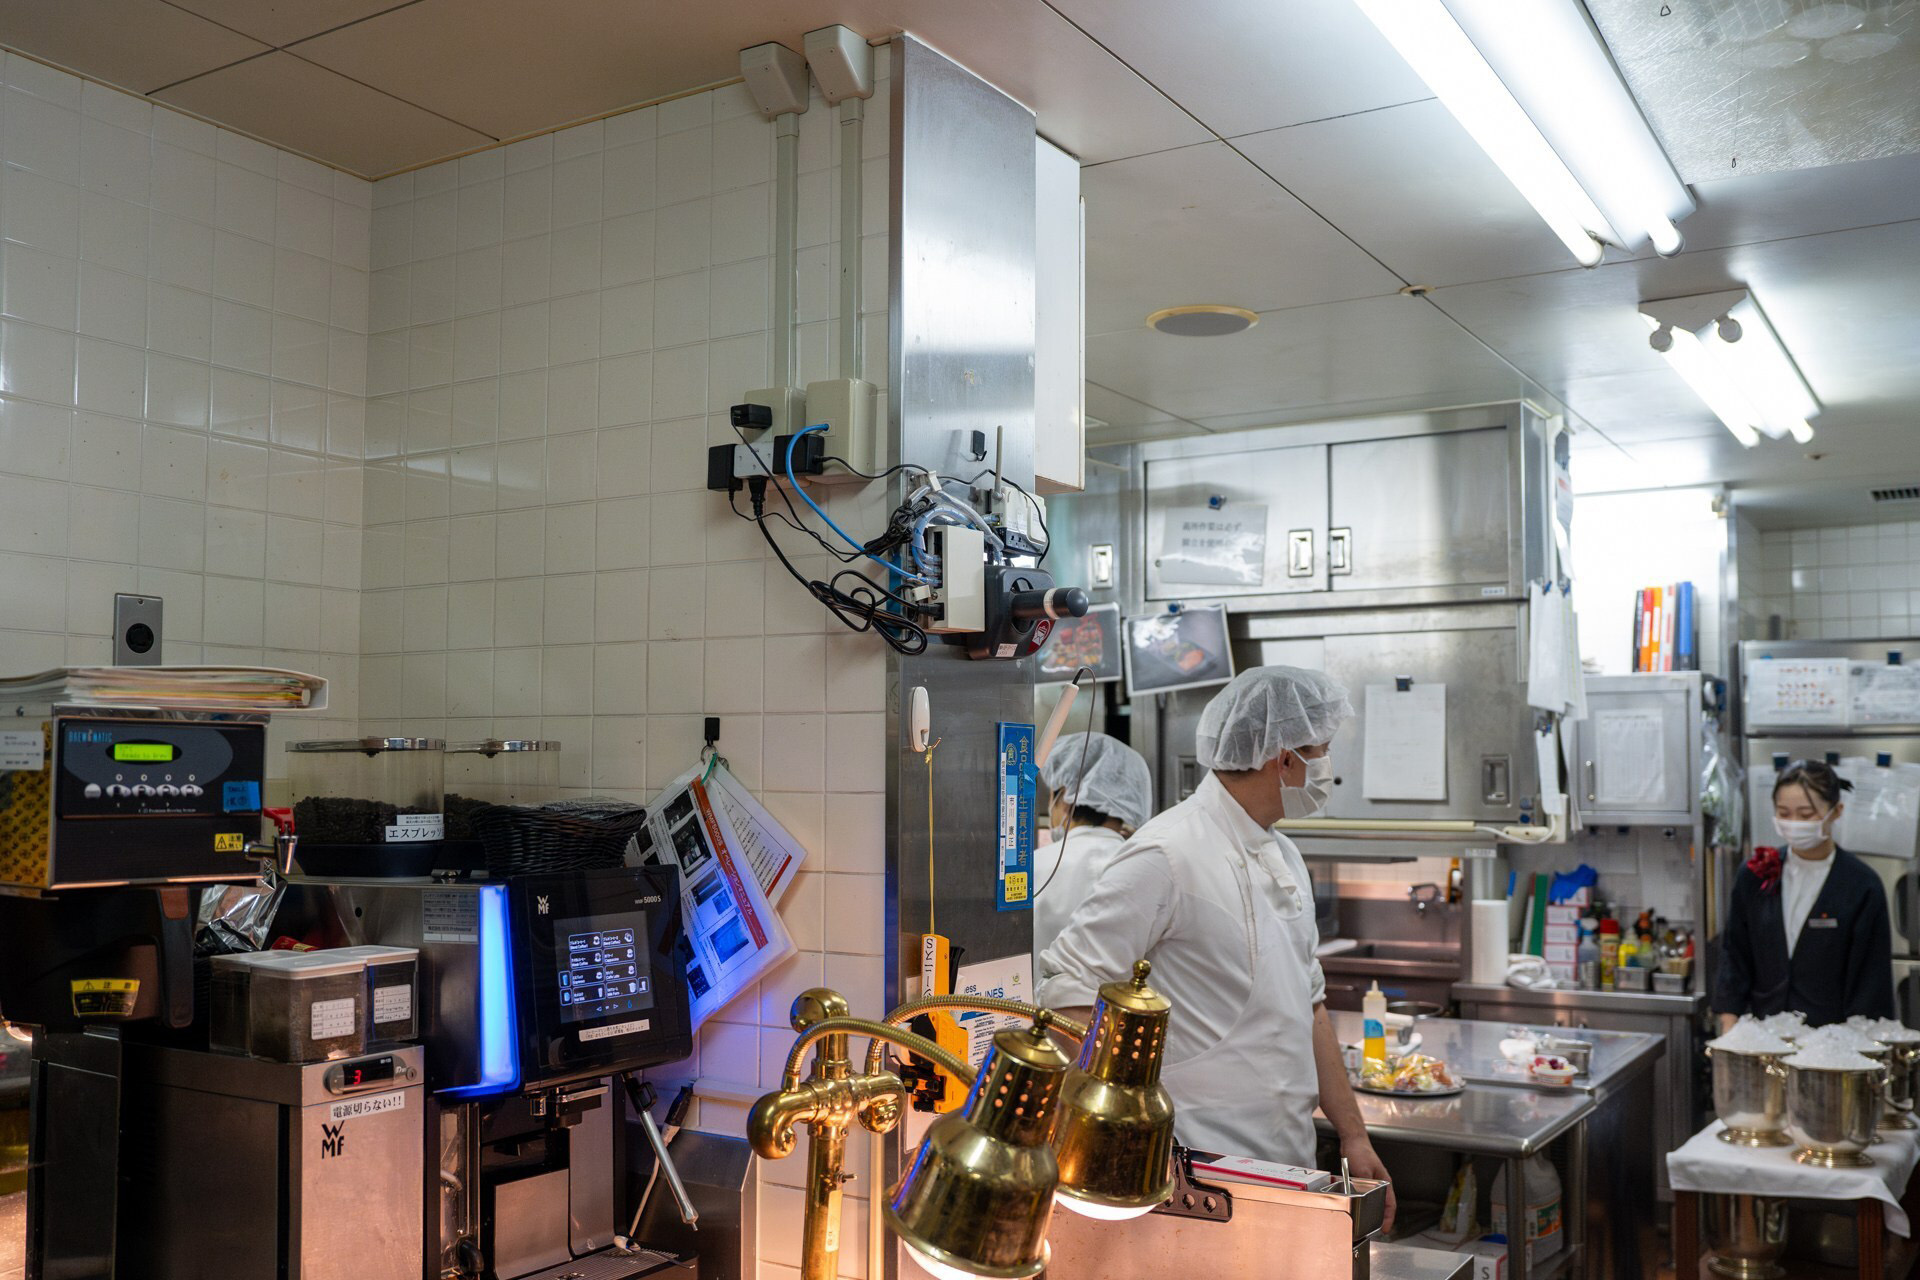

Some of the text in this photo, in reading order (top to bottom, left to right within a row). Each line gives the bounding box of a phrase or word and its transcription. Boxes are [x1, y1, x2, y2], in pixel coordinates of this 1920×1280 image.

[721, 848, 753, 916] オペレーションマニュアル
[333, 1096, 401, 1119] 電源切らない!!
